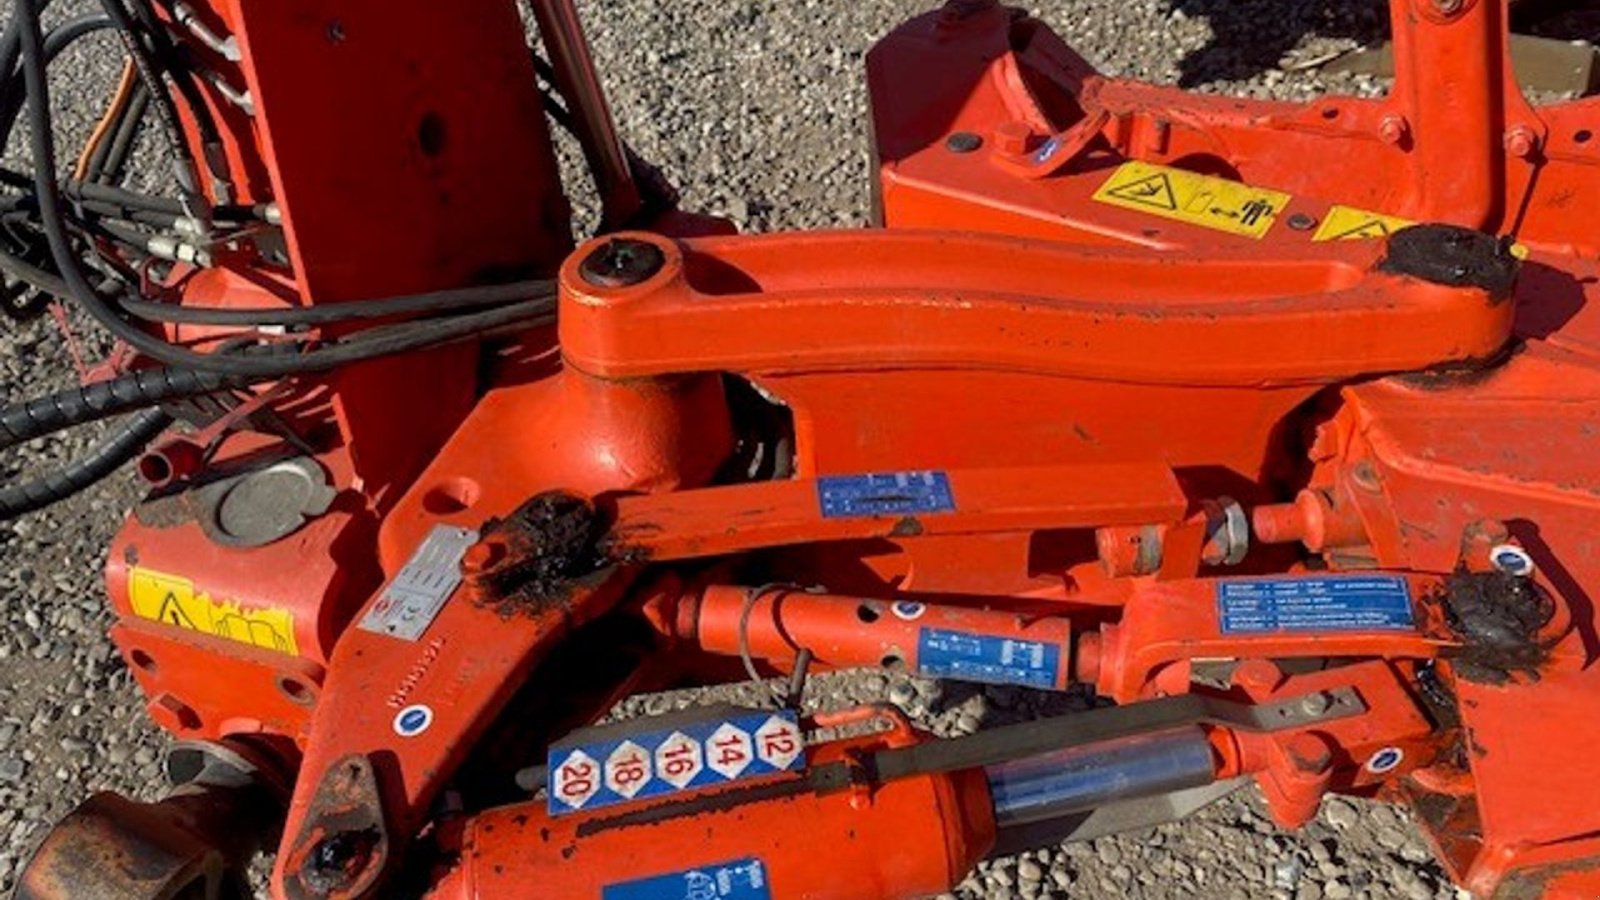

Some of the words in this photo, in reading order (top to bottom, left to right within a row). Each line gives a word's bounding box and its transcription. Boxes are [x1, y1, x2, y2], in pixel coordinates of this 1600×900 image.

[715, 735, 745, 765] 14
[764, 727, 794, 758] 12
[615, 753, 643, 785] 18
[665, 743, 693, 776] 16
[562, 763, 591, 796] 20
